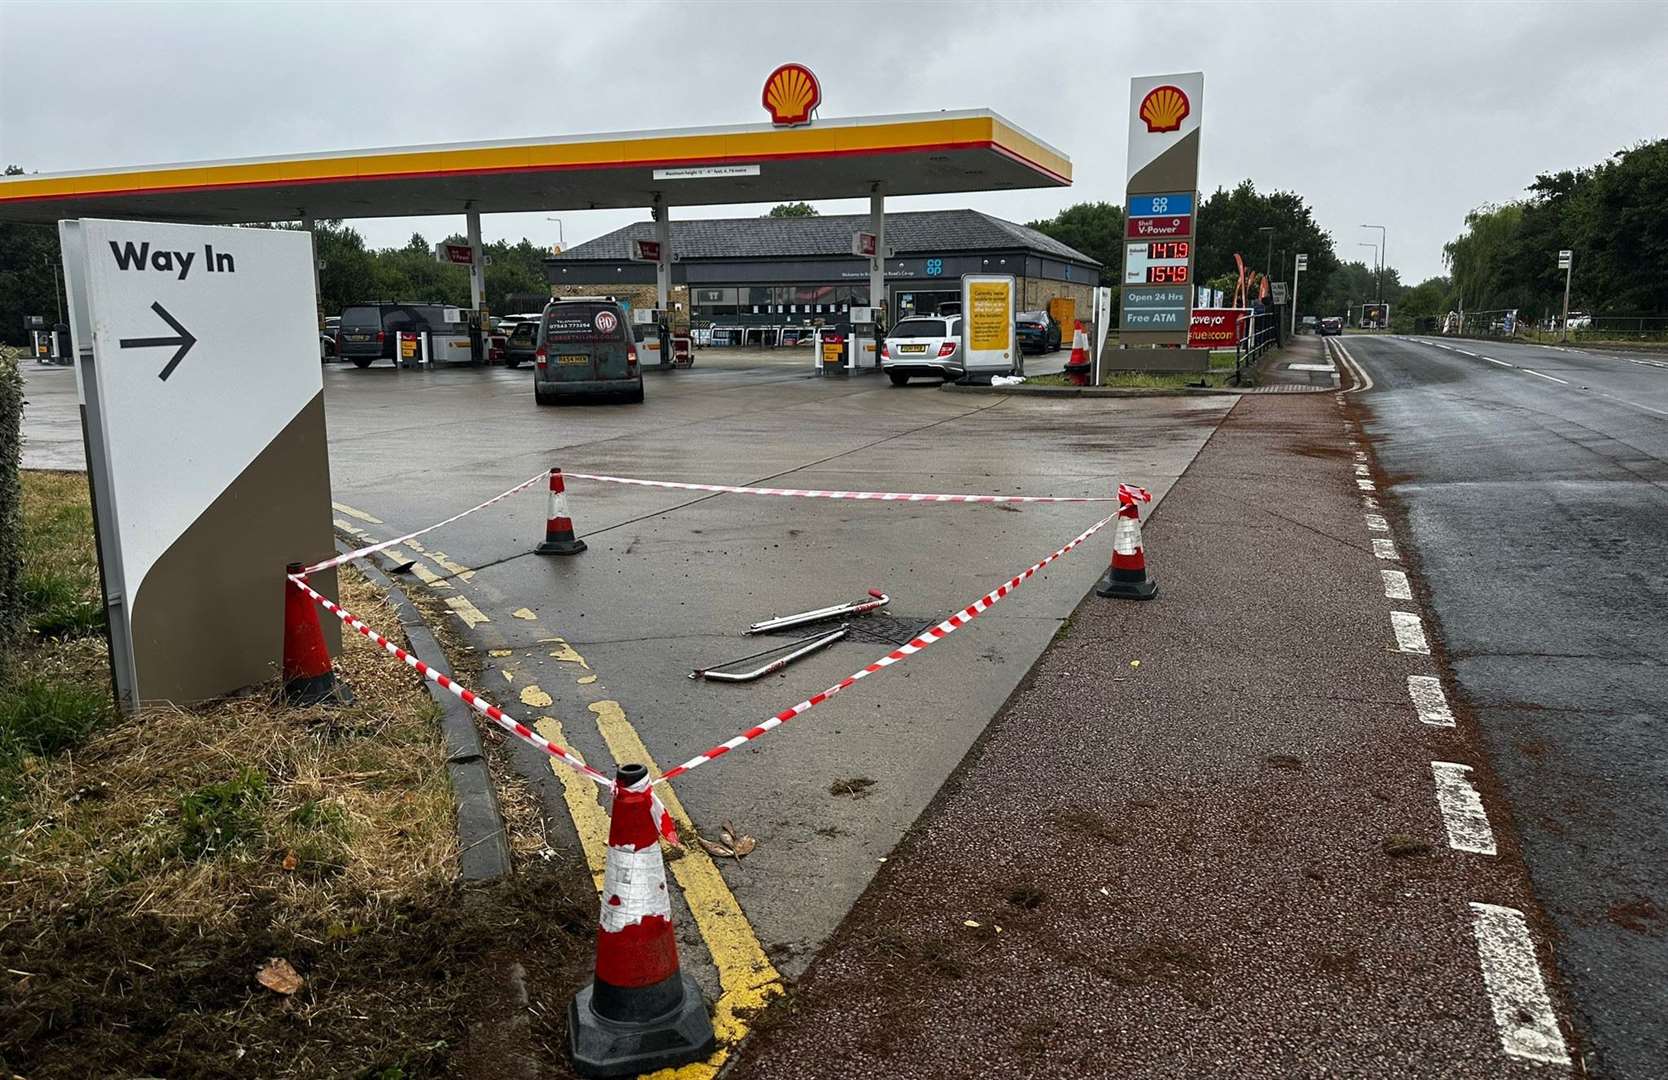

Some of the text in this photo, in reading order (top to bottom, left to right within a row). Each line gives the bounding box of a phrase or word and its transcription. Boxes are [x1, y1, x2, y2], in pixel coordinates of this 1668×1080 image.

[1138, 226, 1177, 234] V-Power
[108, 241, 235, 281] Way In
[1128, 293, 1183, 303] Open 24 Hrs
[1127, 313, 1176, 323] Free ATM
